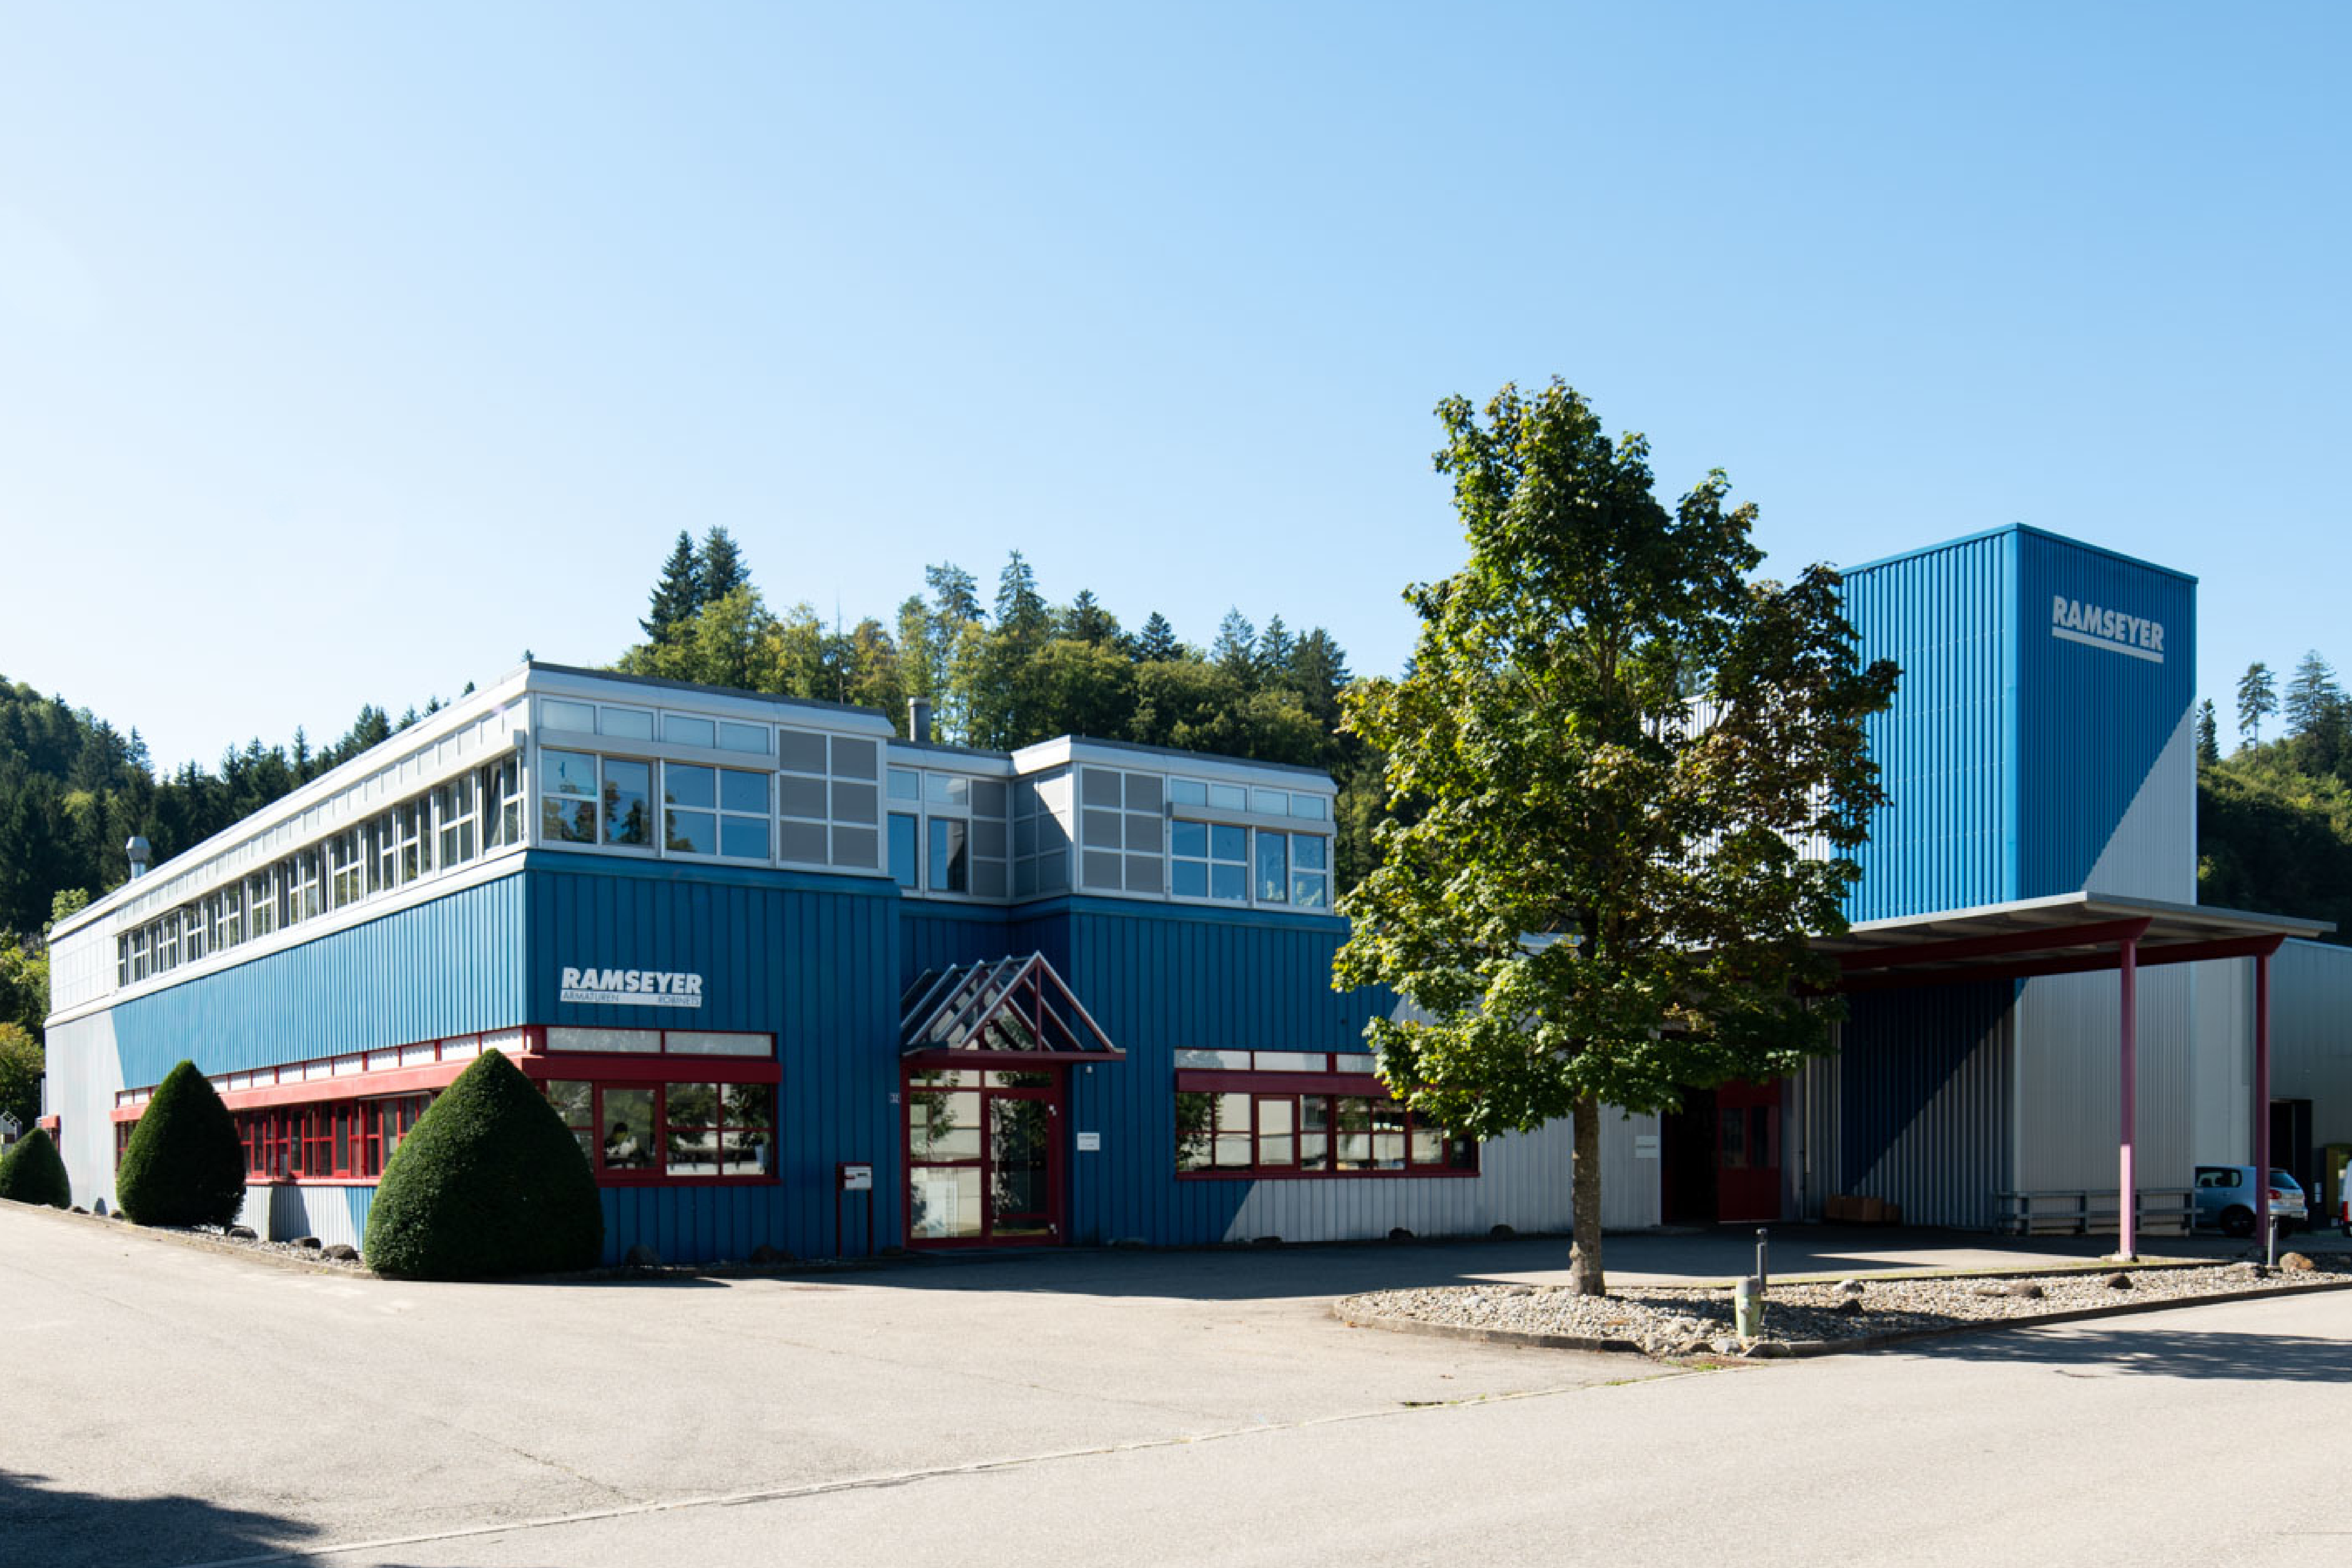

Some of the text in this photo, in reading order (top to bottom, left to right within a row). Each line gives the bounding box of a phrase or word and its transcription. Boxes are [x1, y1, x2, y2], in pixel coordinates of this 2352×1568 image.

[2053, 595, 2163, 651] RAMSEYER
[562, 967, 703, 994] RAMSEYER
[563, 991, 619, 1002] ARMATUREN
